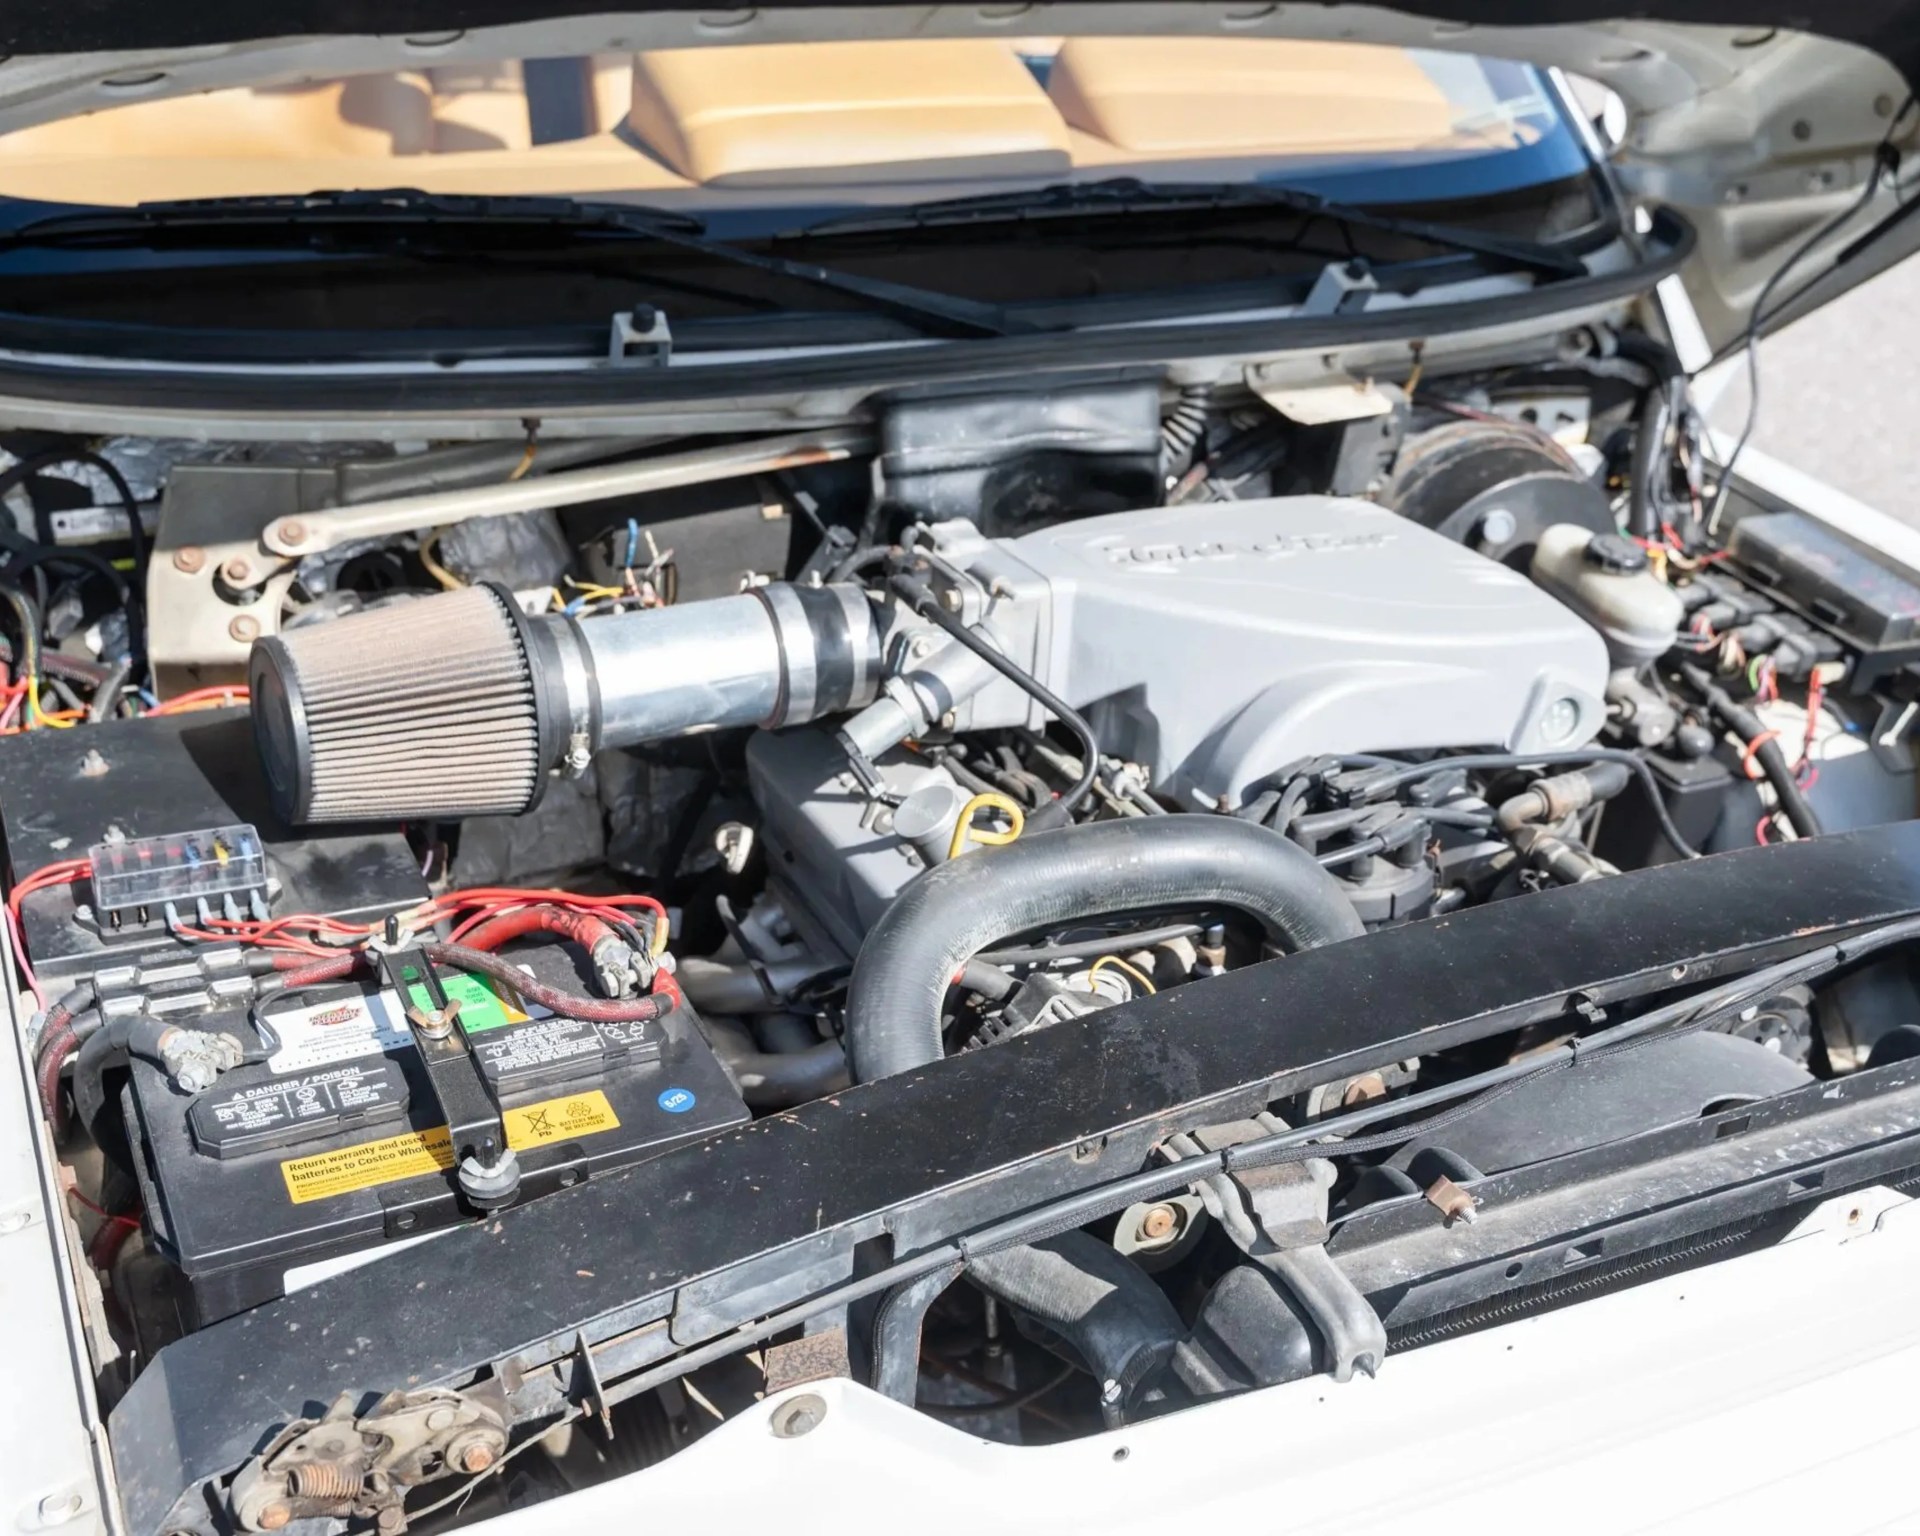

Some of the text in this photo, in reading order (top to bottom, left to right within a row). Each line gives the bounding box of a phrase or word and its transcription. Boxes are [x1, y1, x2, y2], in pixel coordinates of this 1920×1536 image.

[246, 1066, 361, 1098] DANGER / POISON
[664, 1092, 688, 1109] 5/25
[538, 1129, 553, 1138] Pb
[288, 1133, 427, 1172] Return warranty and used
[291, 1158, 342, 1182] batteries
[343, 1160, 356, 1170] to
[357, 1151, 396, 1167] Costco
